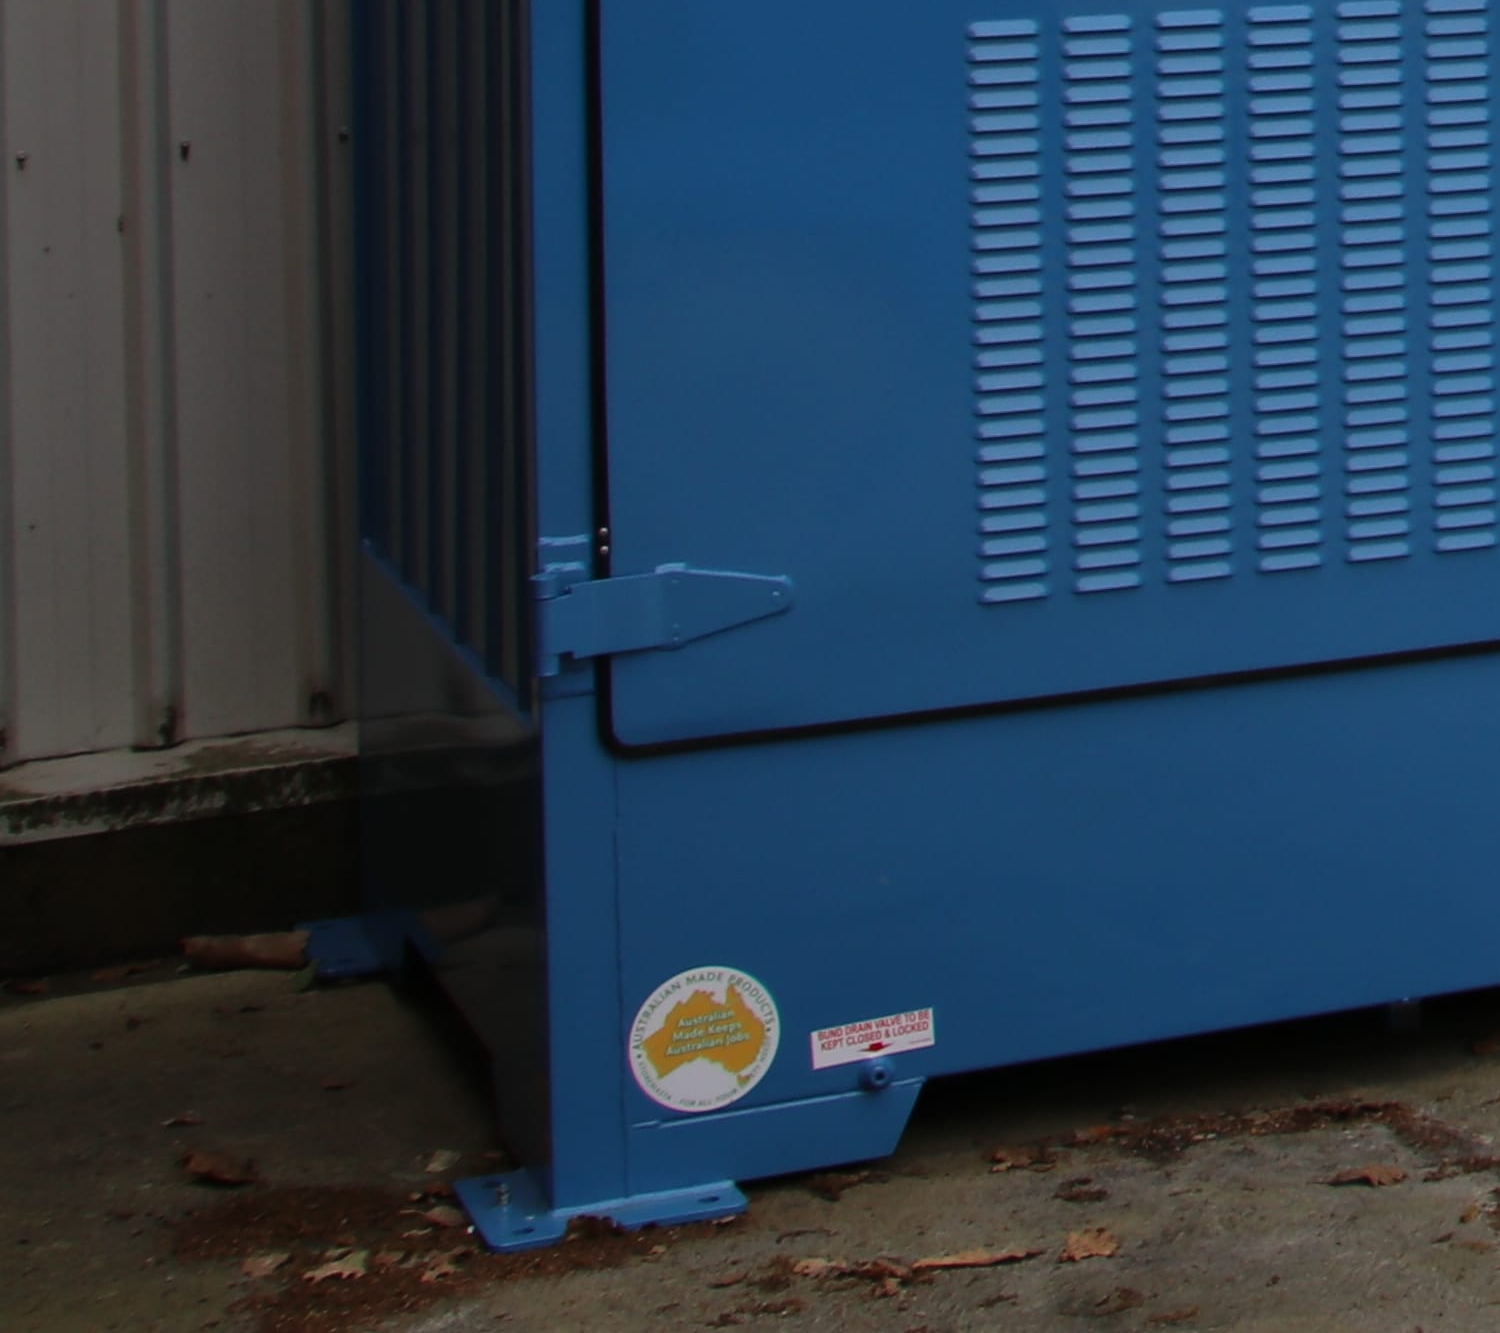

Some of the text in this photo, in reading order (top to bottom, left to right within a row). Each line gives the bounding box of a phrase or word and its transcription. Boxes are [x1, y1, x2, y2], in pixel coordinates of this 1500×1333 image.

[632, 972, 775, 1050] AUSTRALIAN MADE PRODUCTS
[678, 1009, 735, 1027] Australian
[673, 1021, 742, 1042] Made Keeps
[819, 1010, 929, 1040] BUND DRAIN VALVE TO BE
[821, 1038, 844, 1050] KEPT
[847, 1031, 881, 1045] CLOSED
[893, 1021, 928, 1036] LOCKED
[666, 1039, 722, 1056] Australian
